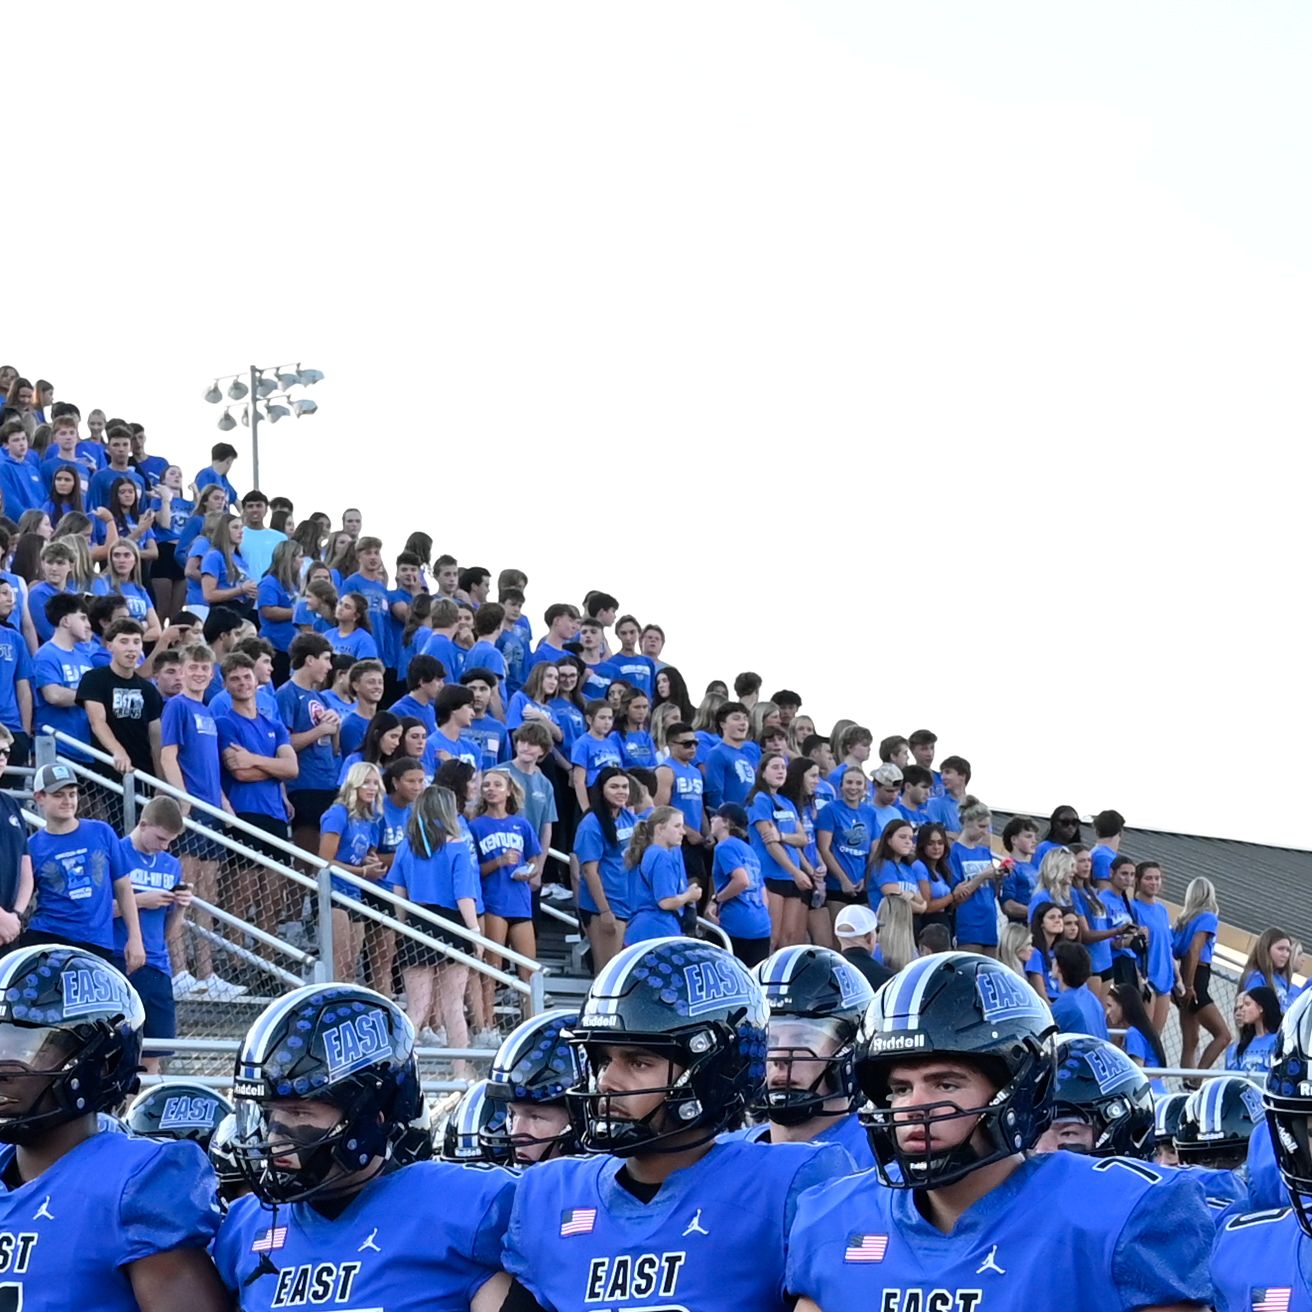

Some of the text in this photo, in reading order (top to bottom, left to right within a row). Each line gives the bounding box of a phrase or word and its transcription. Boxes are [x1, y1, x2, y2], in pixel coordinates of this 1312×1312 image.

[975, 972, 1038, 1011] EAS
[321, 1007, 392, 1071] EAST
[581, 1016, 617, 1027] Riddell
[872, 1034, 925, 1051] Riddell
[1082, 1046, 1132, 1088] EAS
[160, 1096, 218, 1122] EAST
[270, 1261, 361, 1309] EAST
[585, 1251, 686, 1304] EAST
